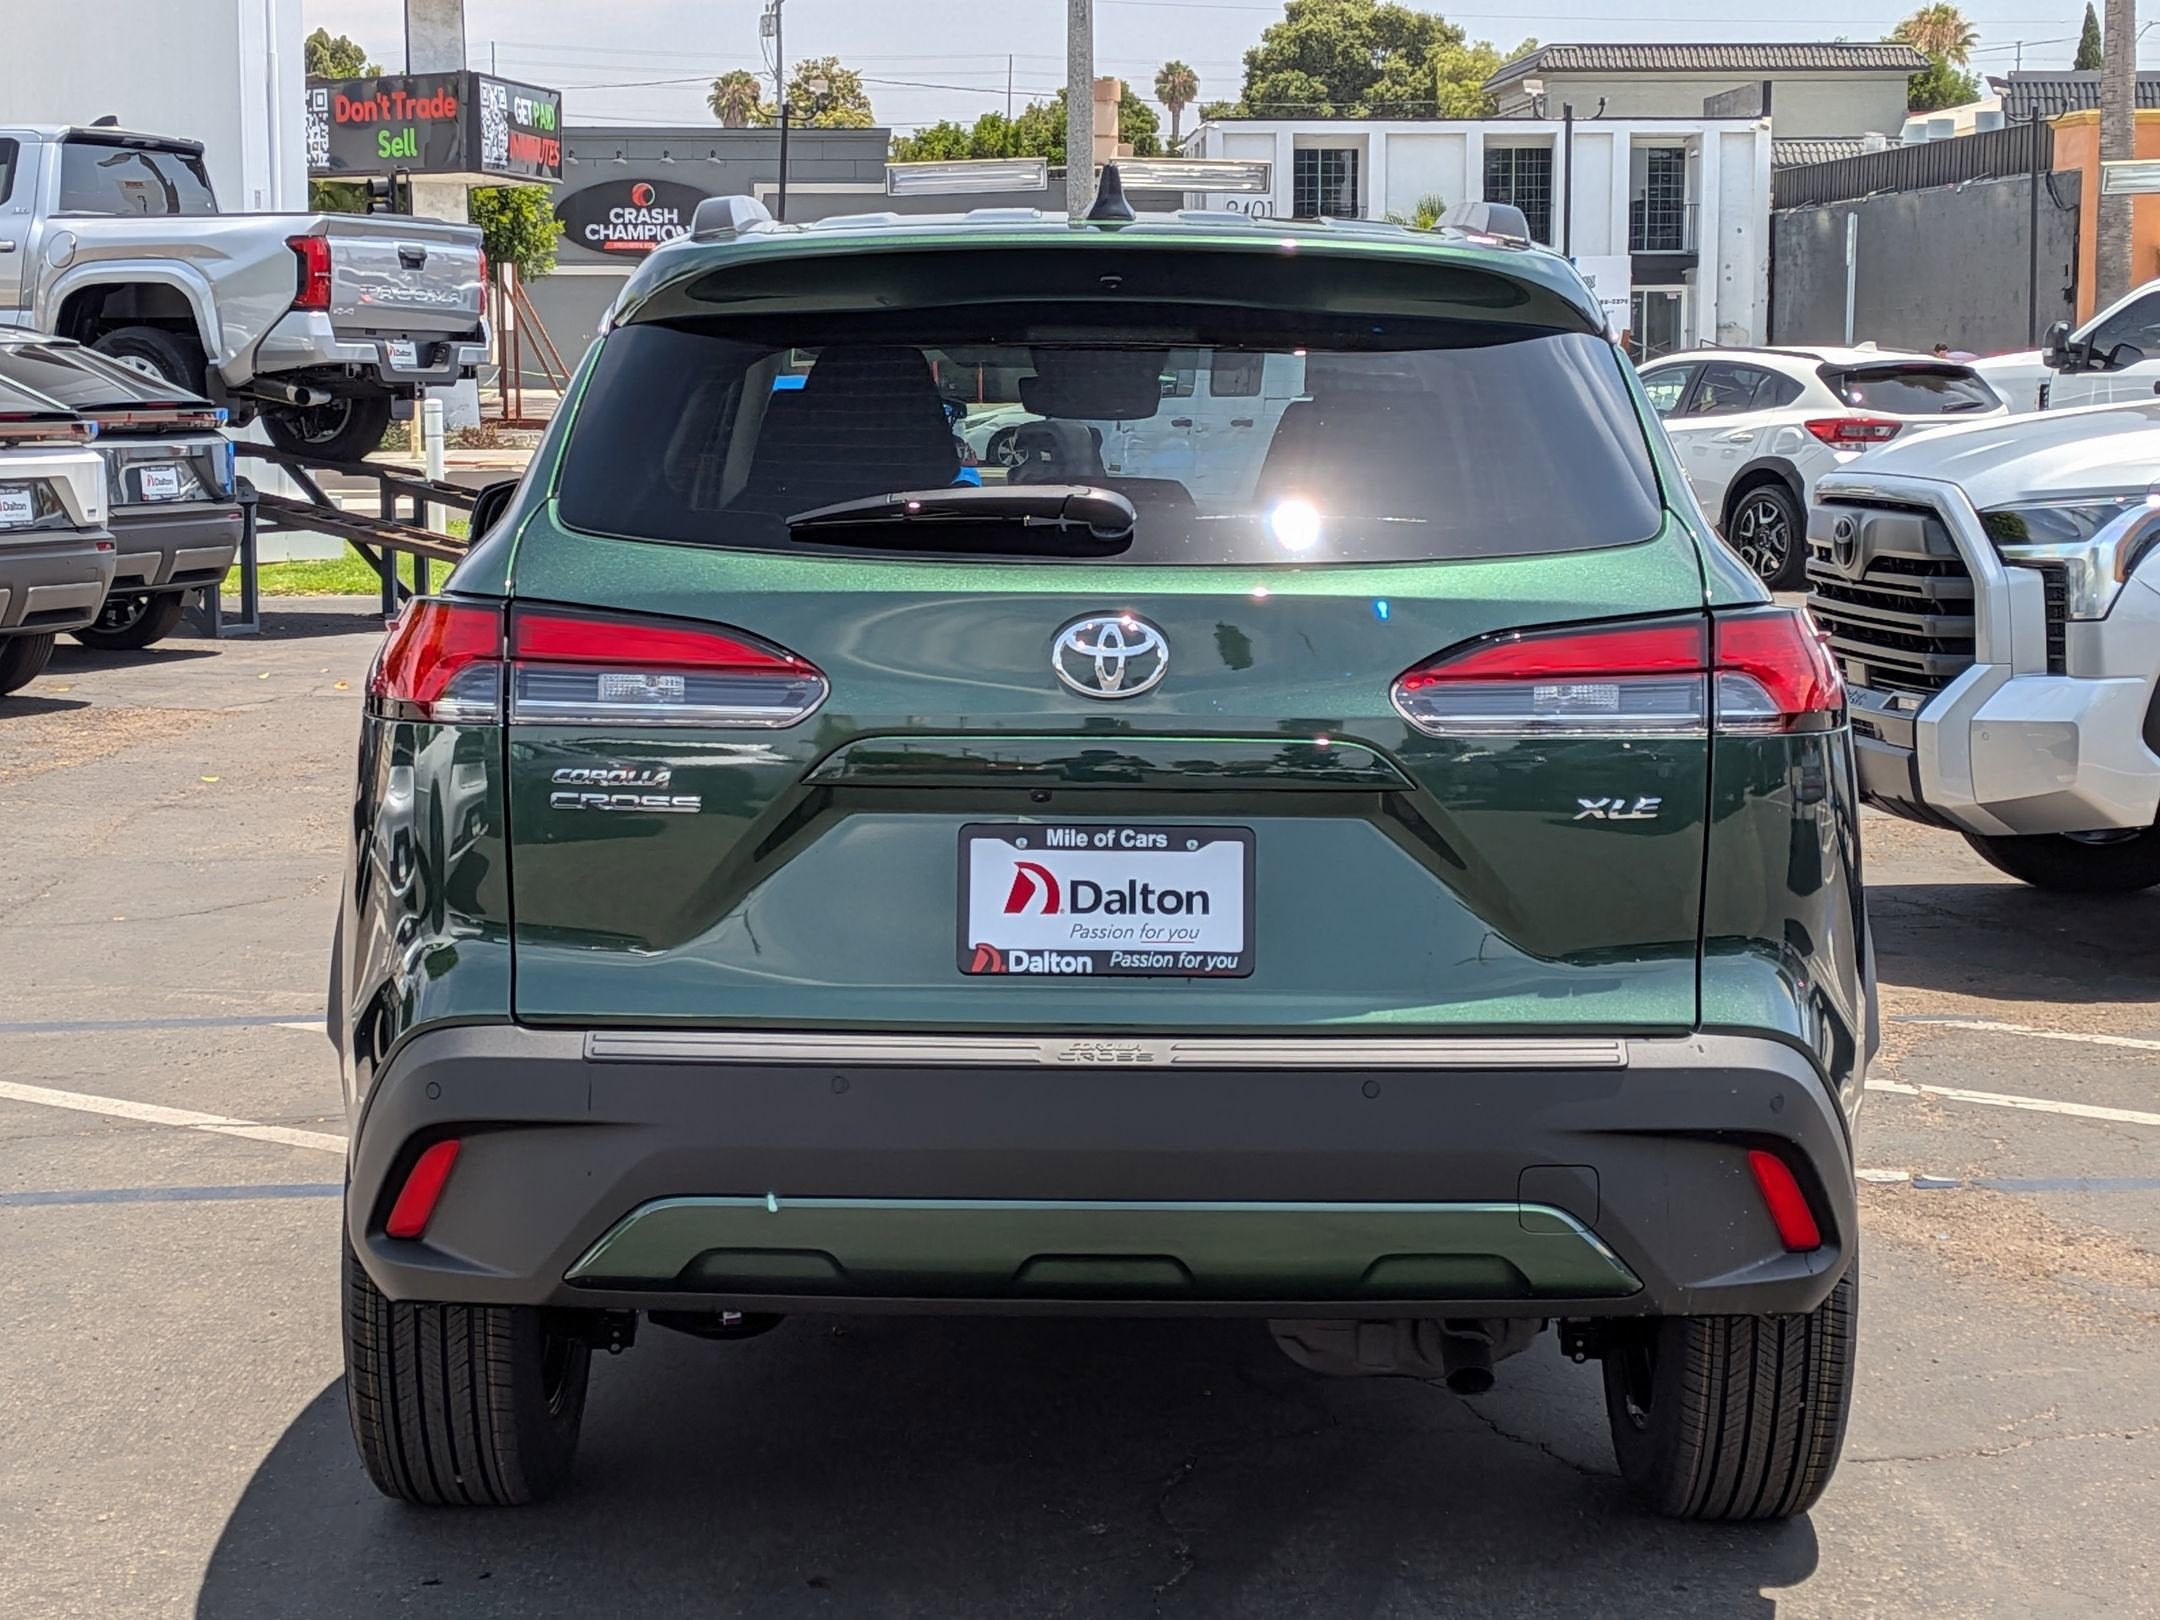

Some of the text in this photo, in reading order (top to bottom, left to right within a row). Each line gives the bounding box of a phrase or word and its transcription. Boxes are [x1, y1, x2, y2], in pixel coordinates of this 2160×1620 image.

[335, 87, 457, 123] Don't Trade
[514, 96, 555, 131] GET PAID
[378, 127, 418, 158] Sell
[609, 207, 679, 224] CRASH
[2, 501, 27, 512] Dalton
[552, 768, 672, 788] COROLLA
[550, 792, 702, 814] CROSS
[1572, 797, 1663, 820] XLE
[1046, 829, 1169, 849] Mile of Cars
[1069, 879, 1211, 916] Dalton
[1069, 923, 1200, 942] Passion for you
[1008, 950, 1239, 974] Dalton Passion for you
